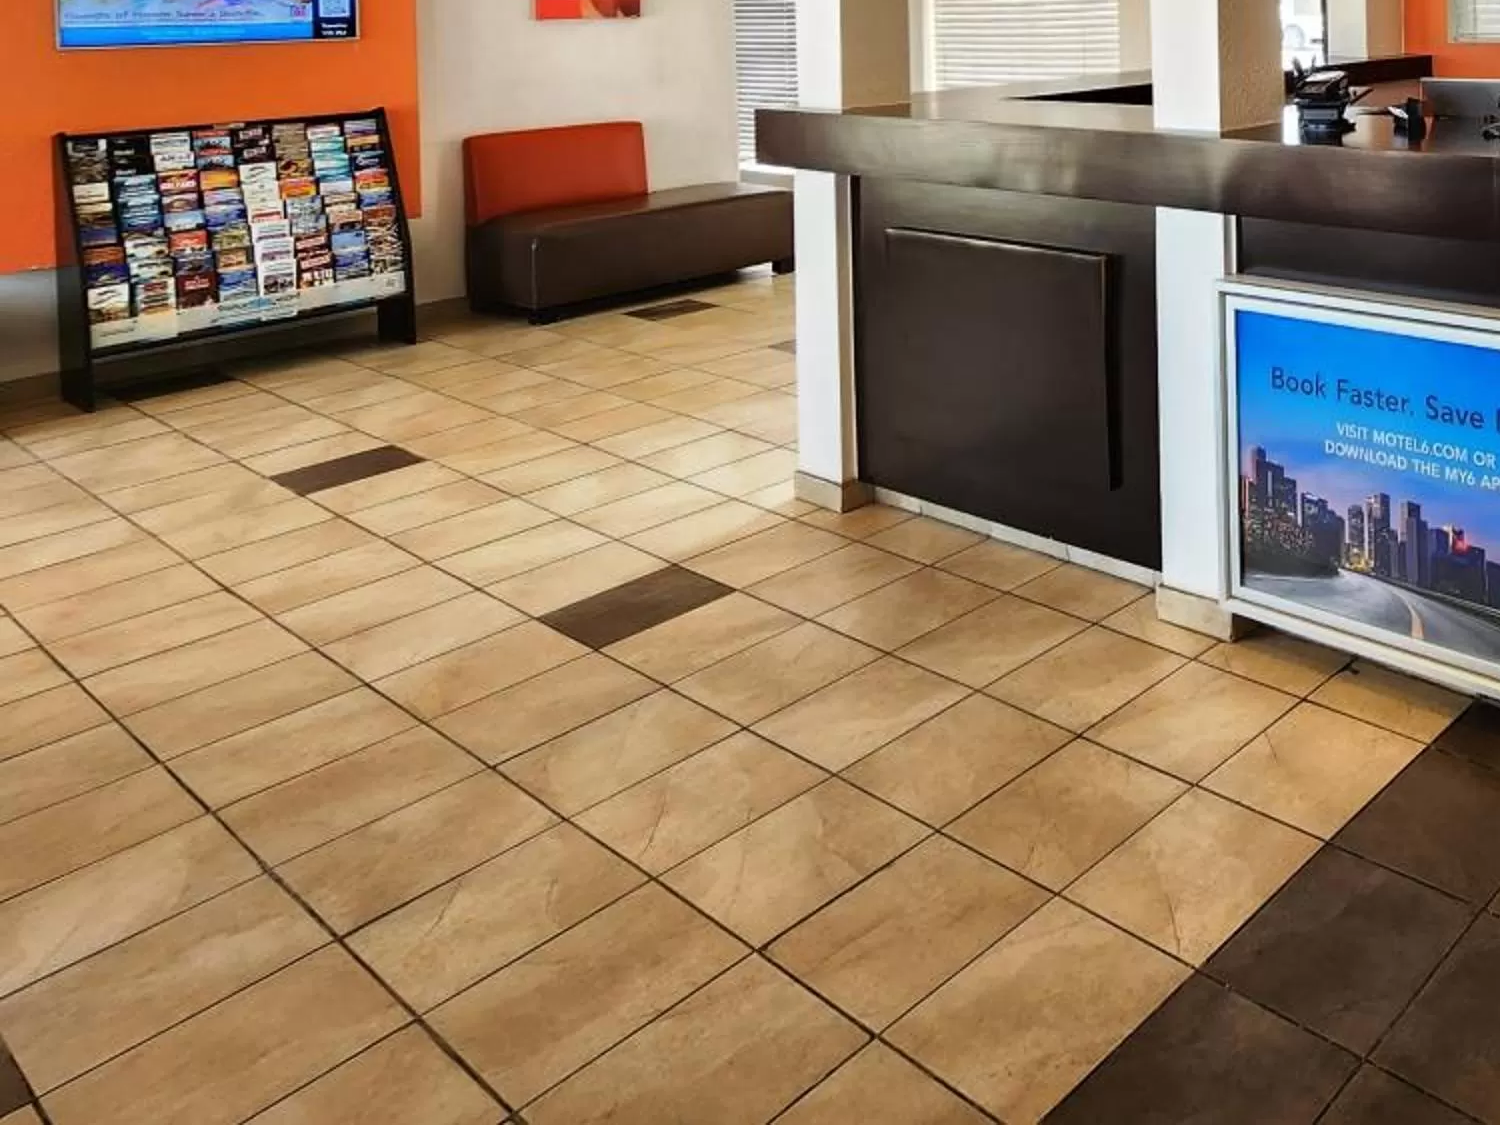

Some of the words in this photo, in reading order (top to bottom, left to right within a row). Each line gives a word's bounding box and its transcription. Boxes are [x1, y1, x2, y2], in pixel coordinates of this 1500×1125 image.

[1271, 366, 1326, 399] Book
[1336, 378, 1415, 416] Faster.
[1425, 394, 1485, 429] Save
[1324, 439, 1408, 470] DOWNLOAD
[1411, 458, 1441, 478] THE
[1444, 466, 1476, 486] MY6
[1336, 422, 1369, 441] VISIT
[1373, 430, 1469, 463] MOTEL6.COM
[1473, 448, 1497, 469] OR
